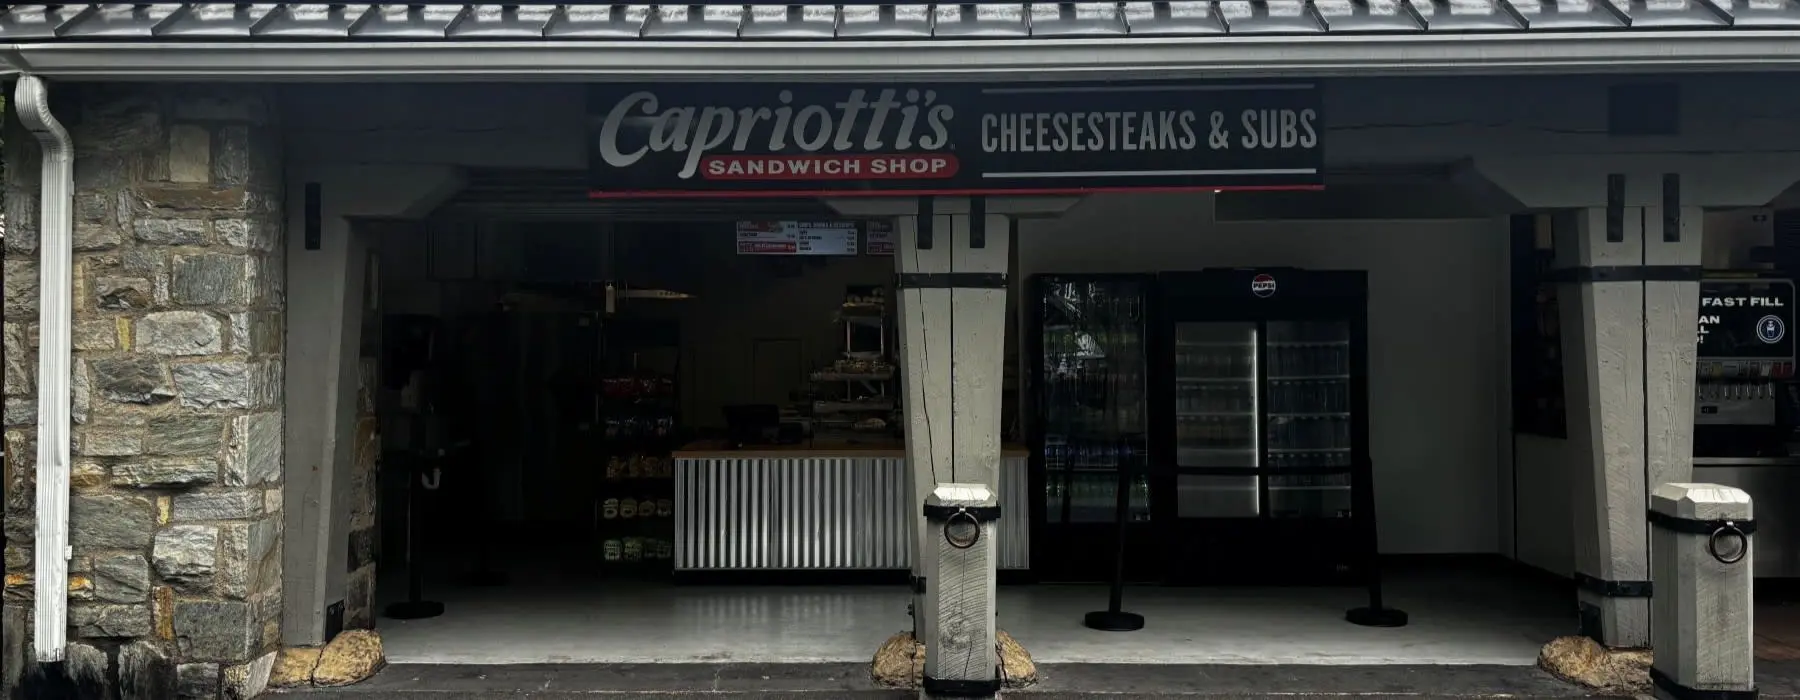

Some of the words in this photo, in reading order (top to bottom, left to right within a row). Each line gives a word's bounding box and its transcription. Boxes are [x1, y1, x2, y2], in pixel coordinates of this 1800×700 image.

[599, 89, 955, 179] Capriotti's
[982, 111, 1196, 152] CHEESESTEAKS
[1208, 109, 1229, 150] &
[1241, 109, 1317, 149] SUBS
[708, 158, 860, 176] SANDWICH
[870, 157, 947, 174] SHOP
[1702, 297, 1747, 307] FAST
[1750, 296, 1784, 307] FILL
